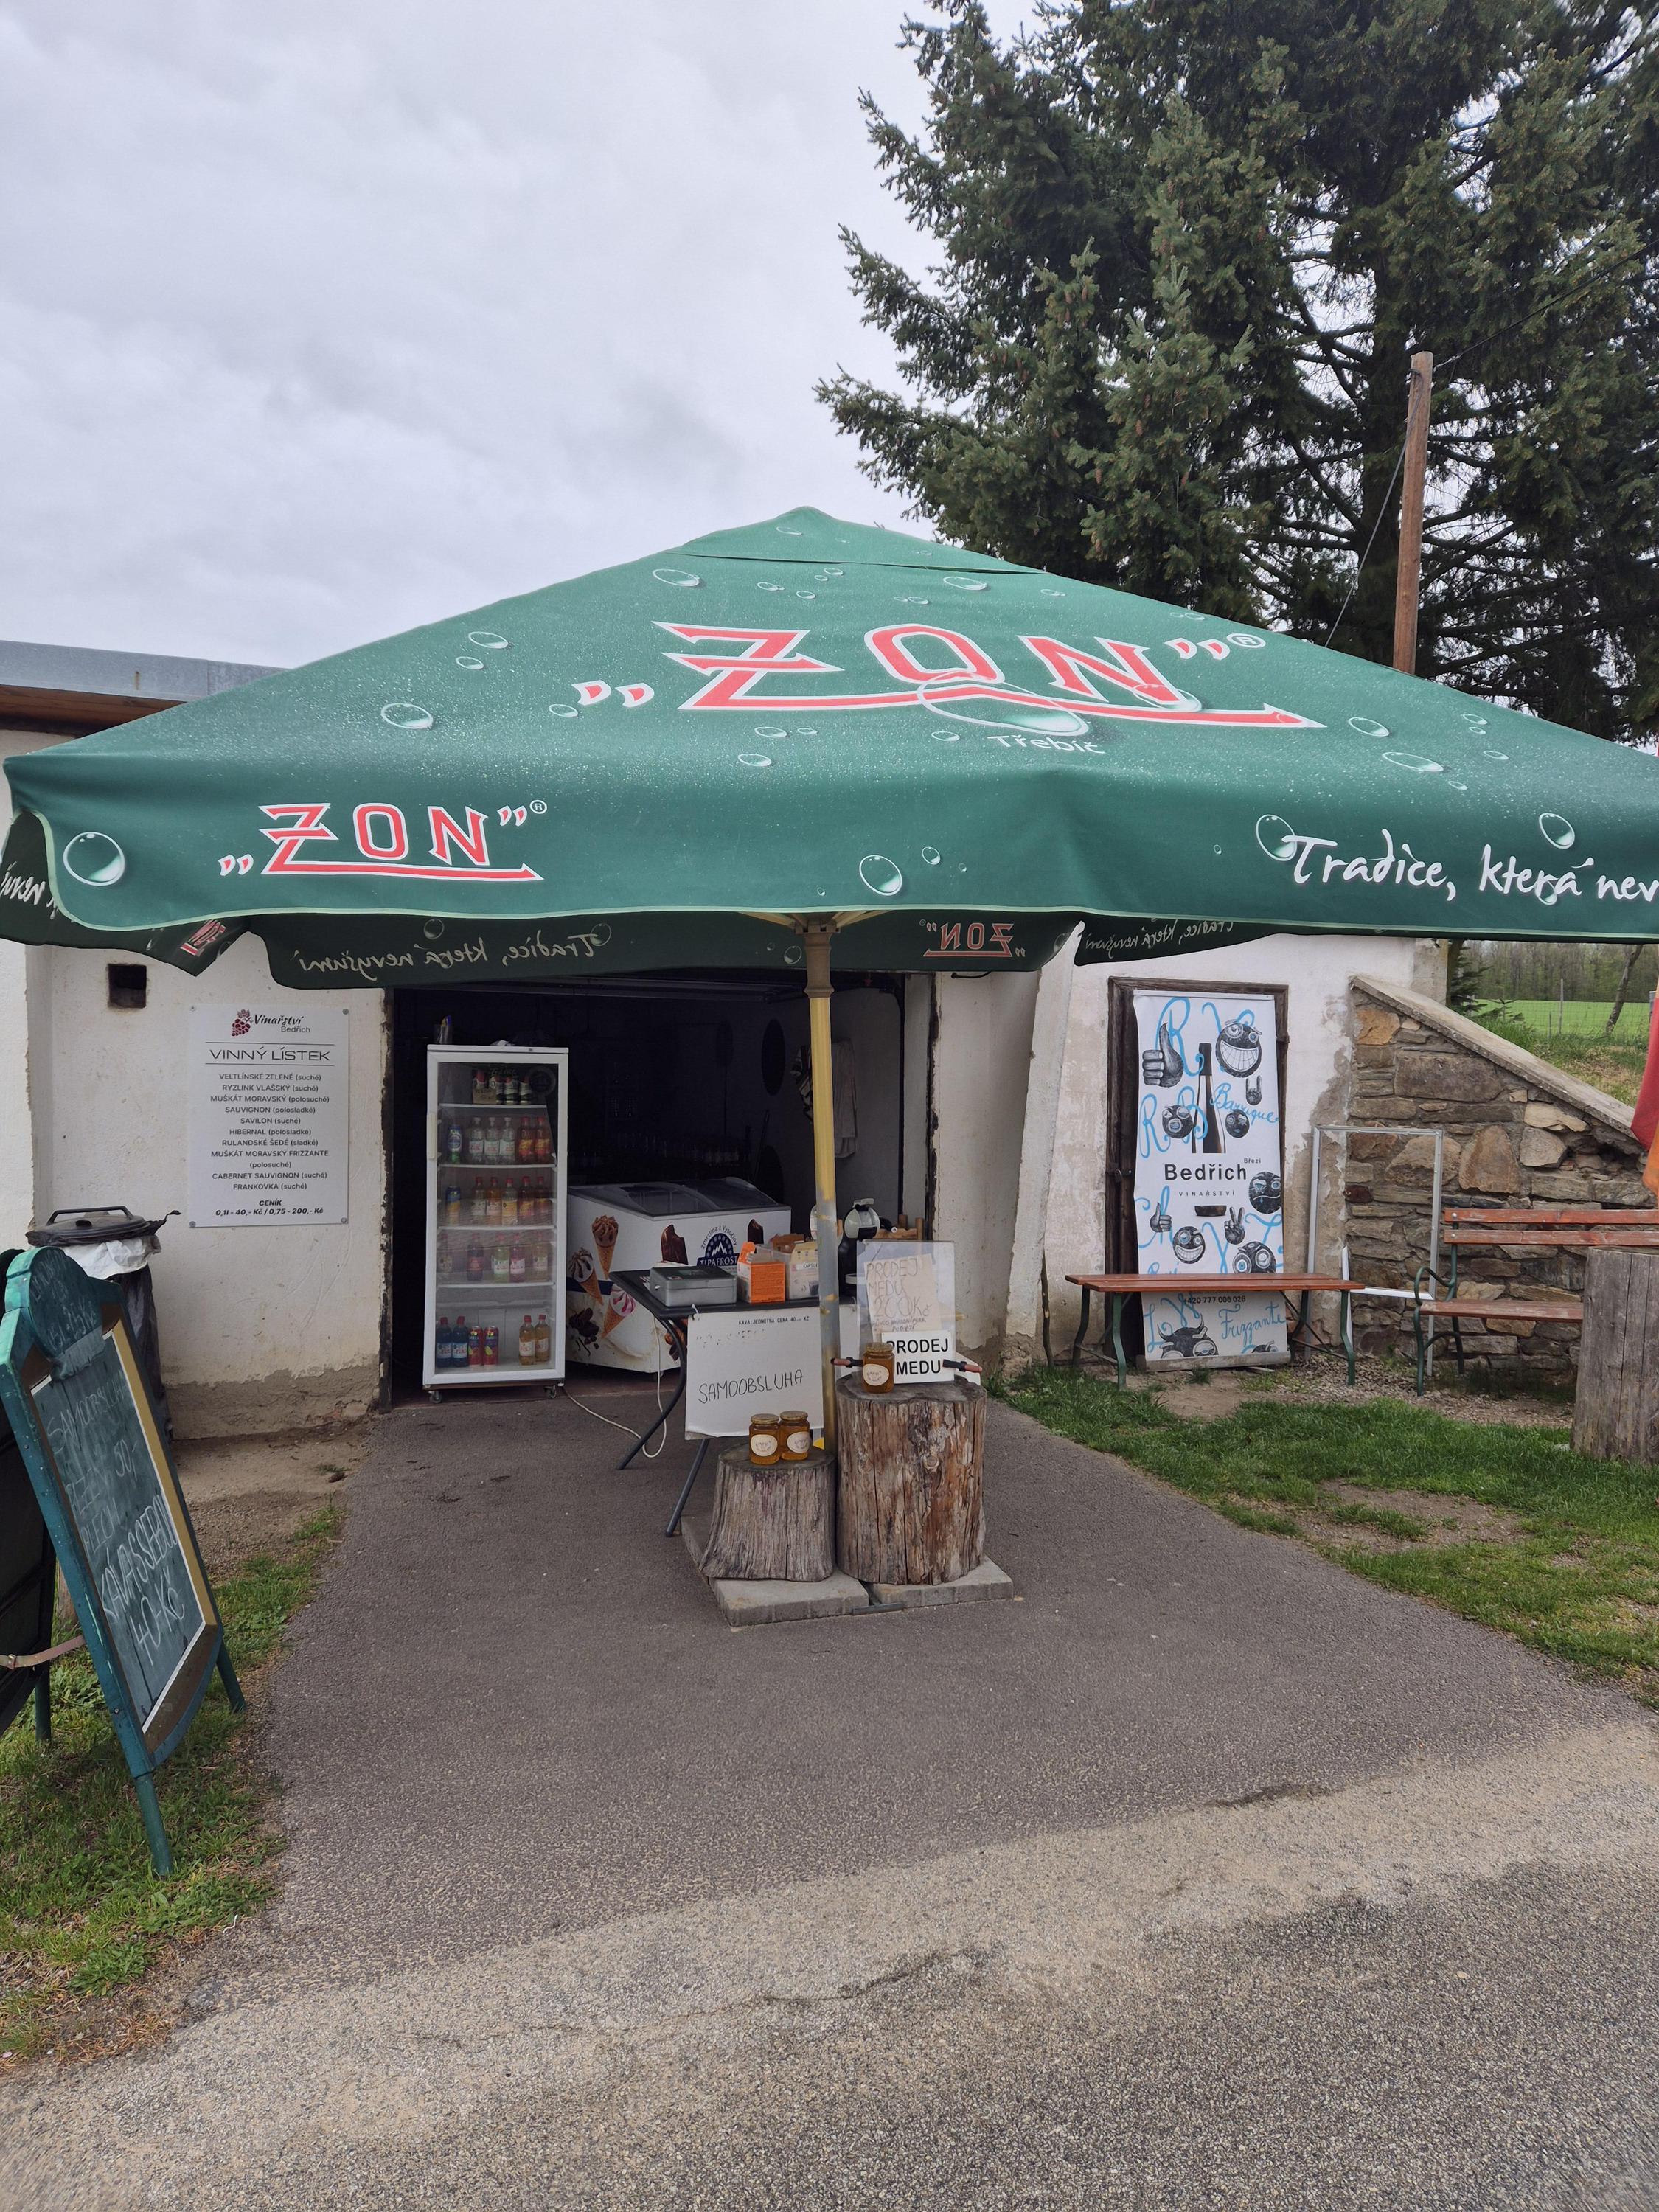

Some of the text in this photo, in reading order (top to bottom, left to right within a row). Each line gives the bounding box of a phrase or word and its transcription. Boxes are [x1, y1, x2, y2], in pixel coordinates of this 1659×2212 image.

[1281, 828, 1457, 902] Tradice,
[1479, 844, 1595, 897] která
[254, 1014, 304, 1025] Vinařství
[209, 1046, 330, 1061] VINNÝ LÍSTEK
[219, 1072, 263, 1080] VELTLÍNSKÉ
[295, 1074, 321, 1082] (suché)
[257, 1083, 291, 1091] VLAŠSKÝ
[292, 1085, 319, 1093] (suché)
[210, 1094, 242, 1102] MUŠKÁT
[288, 1096, 330, 1104] (polosuché)
[274, 1117, 301, 1125] (suché)
[268, 1128, 312, 1136] (polosladké)
[222, 1138, 267, 1147] RULANDSKÉ
[269, 1138, 288, 1146] ŠEDÉ
[245, 1149, 287, 1157] MORAVSKÝ
[301, 1172, 327, 1180] (suché)
[1164, 1164, 1247, 1180] Bedřich
[281, 1183, 307, 1191] (suché)
[259, 1198, 282, 1206] CENÍK
[866, 1258, 918, 1280] PRODEJ
[896, 1360, 941, 1375] MEDU
[698, 1369, 803, 1404] SAMOOBSLUHA
